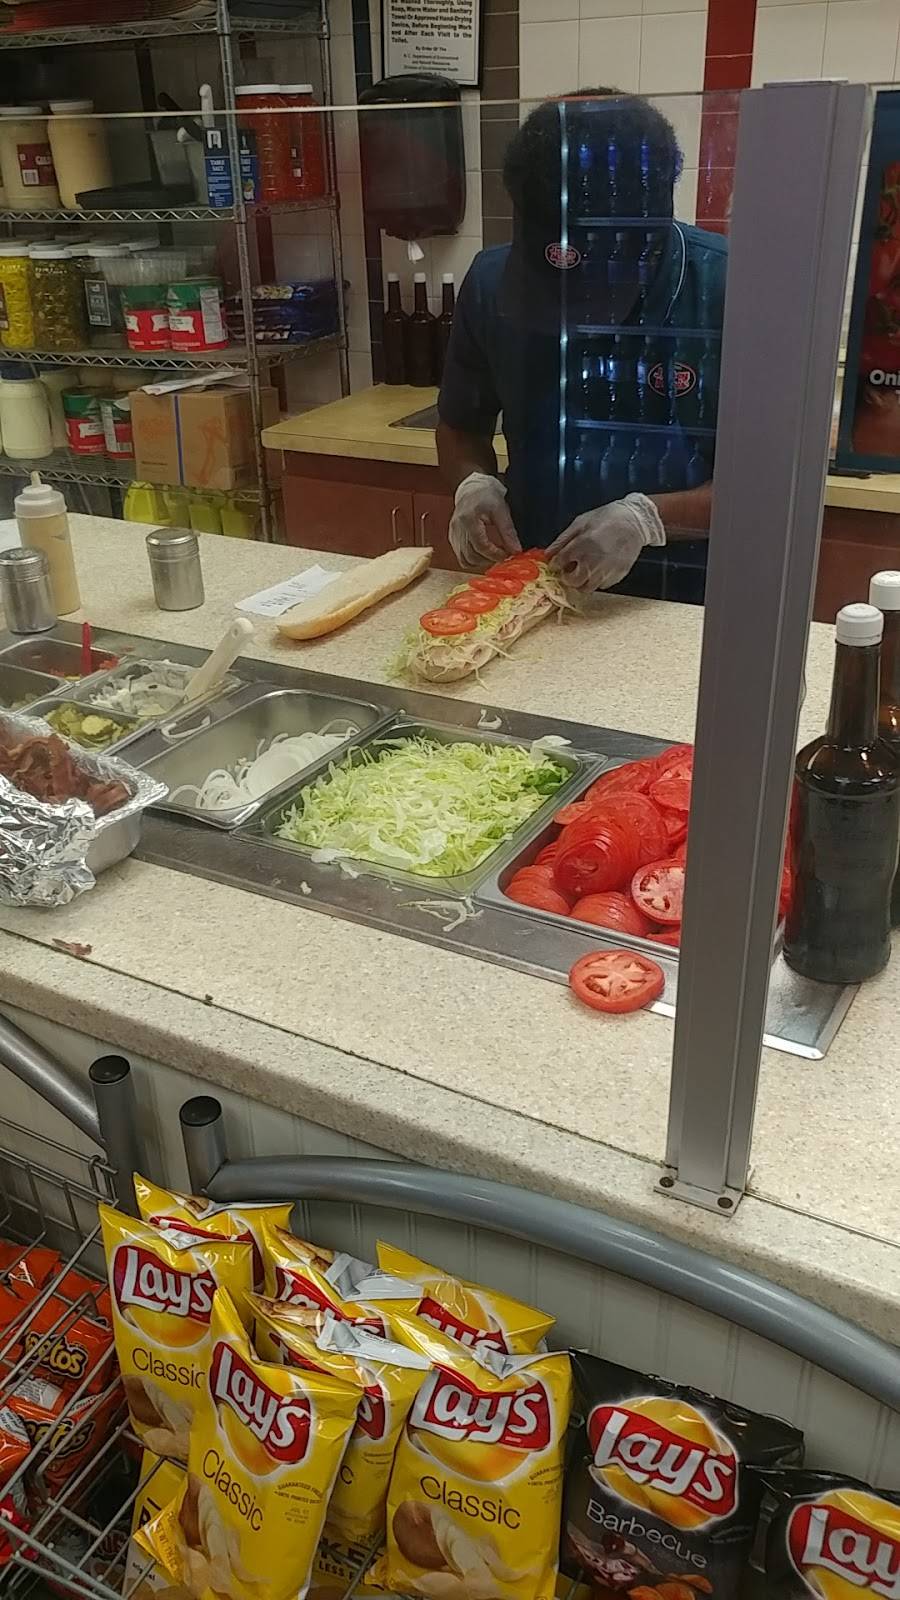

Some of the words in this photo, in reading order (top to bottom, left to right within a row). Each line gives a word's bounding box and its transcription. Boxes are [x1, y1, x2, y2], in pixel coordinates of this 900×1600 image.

[430, 23, 457, 31] Beginning
[120, 1248, 213, 1317] Lay's
[215, 1345, 311, 1448] Lay's
[409, 1369, 543, 1444] Lay's
[594, 1410, 733, 1501] Lay's
[203, 1450, 264, 1532] Classic
[420, 1475, 521, 1530] Classic
[318, 1560, 345, 1577] LESS
[586, 1499, 708, 1569] Barbecue
